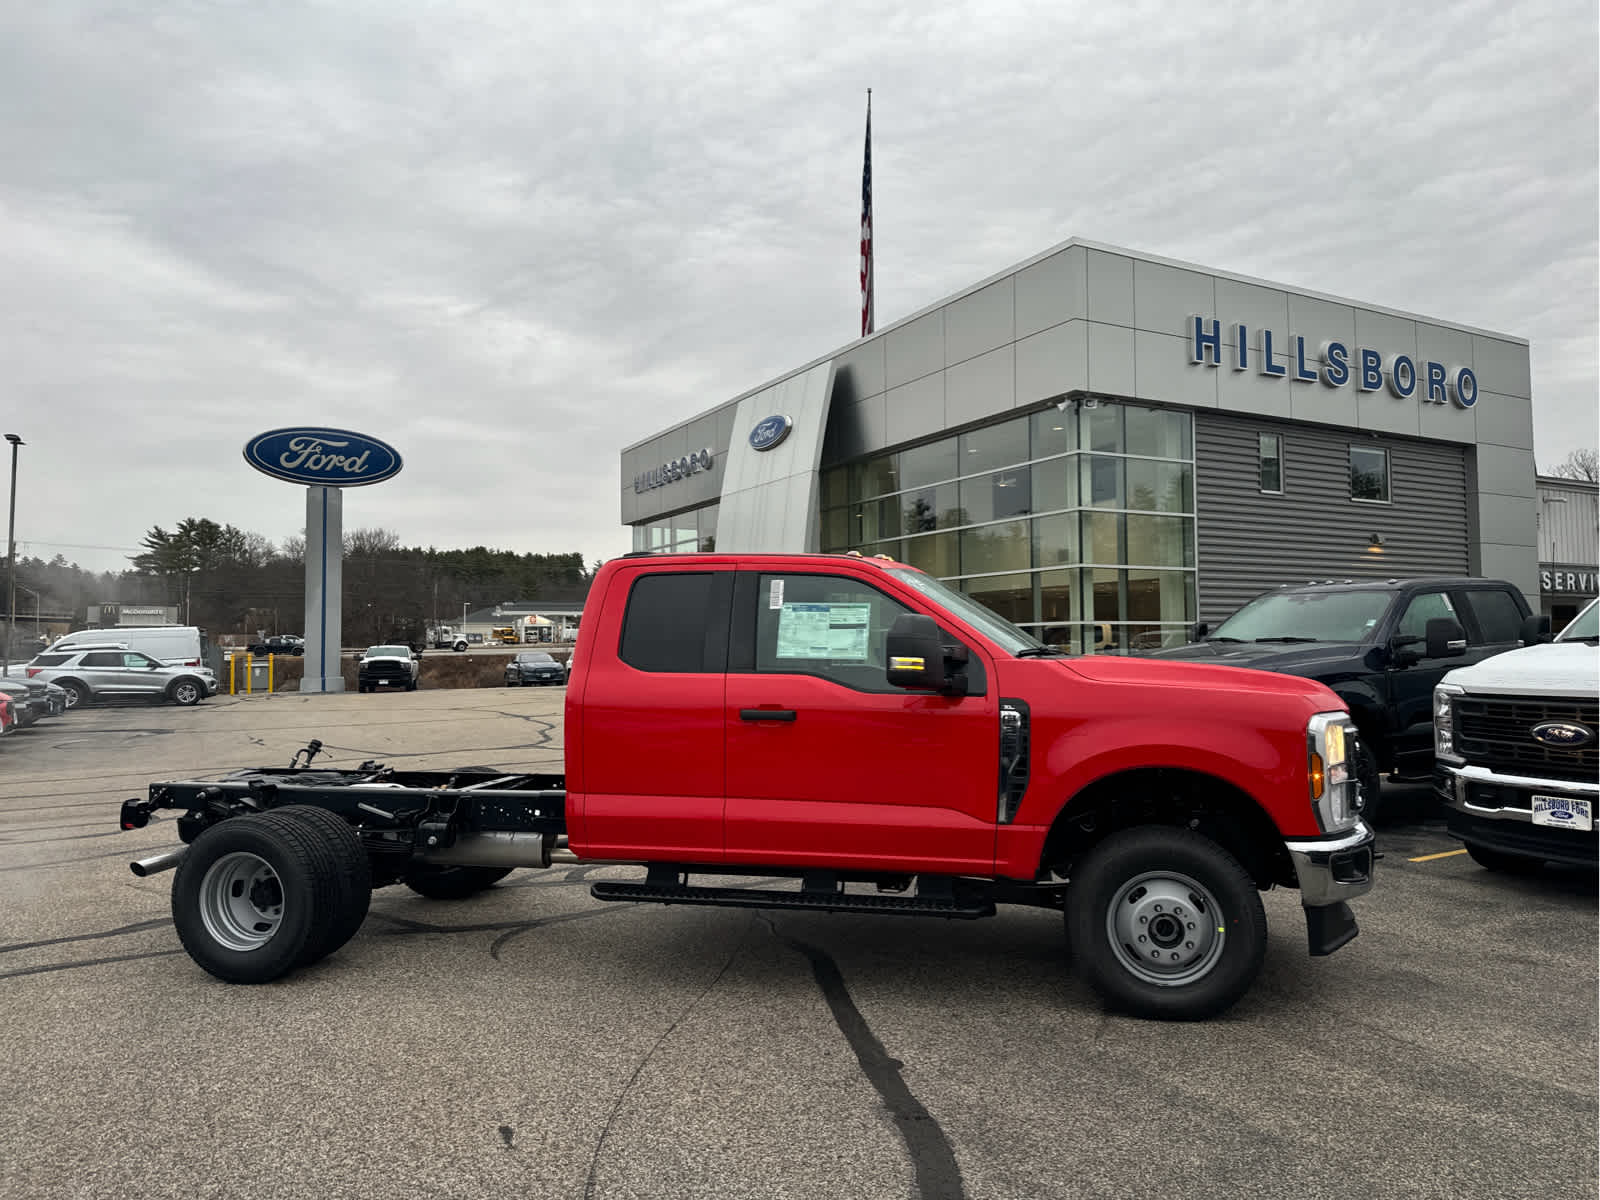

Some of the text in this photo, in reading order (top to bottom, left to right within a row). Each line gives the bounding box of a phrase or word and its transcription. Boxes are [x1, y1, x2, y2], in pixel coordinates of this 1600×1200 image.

[1190, 315, 1478, 409] HILLSBORO
[754, 421, 777, 443] Ford
[279, 436, 371, 473] Ford
[633, 448, 712, 494] HILLSBORO
[1542, 571, 1598, 591] SERVI
